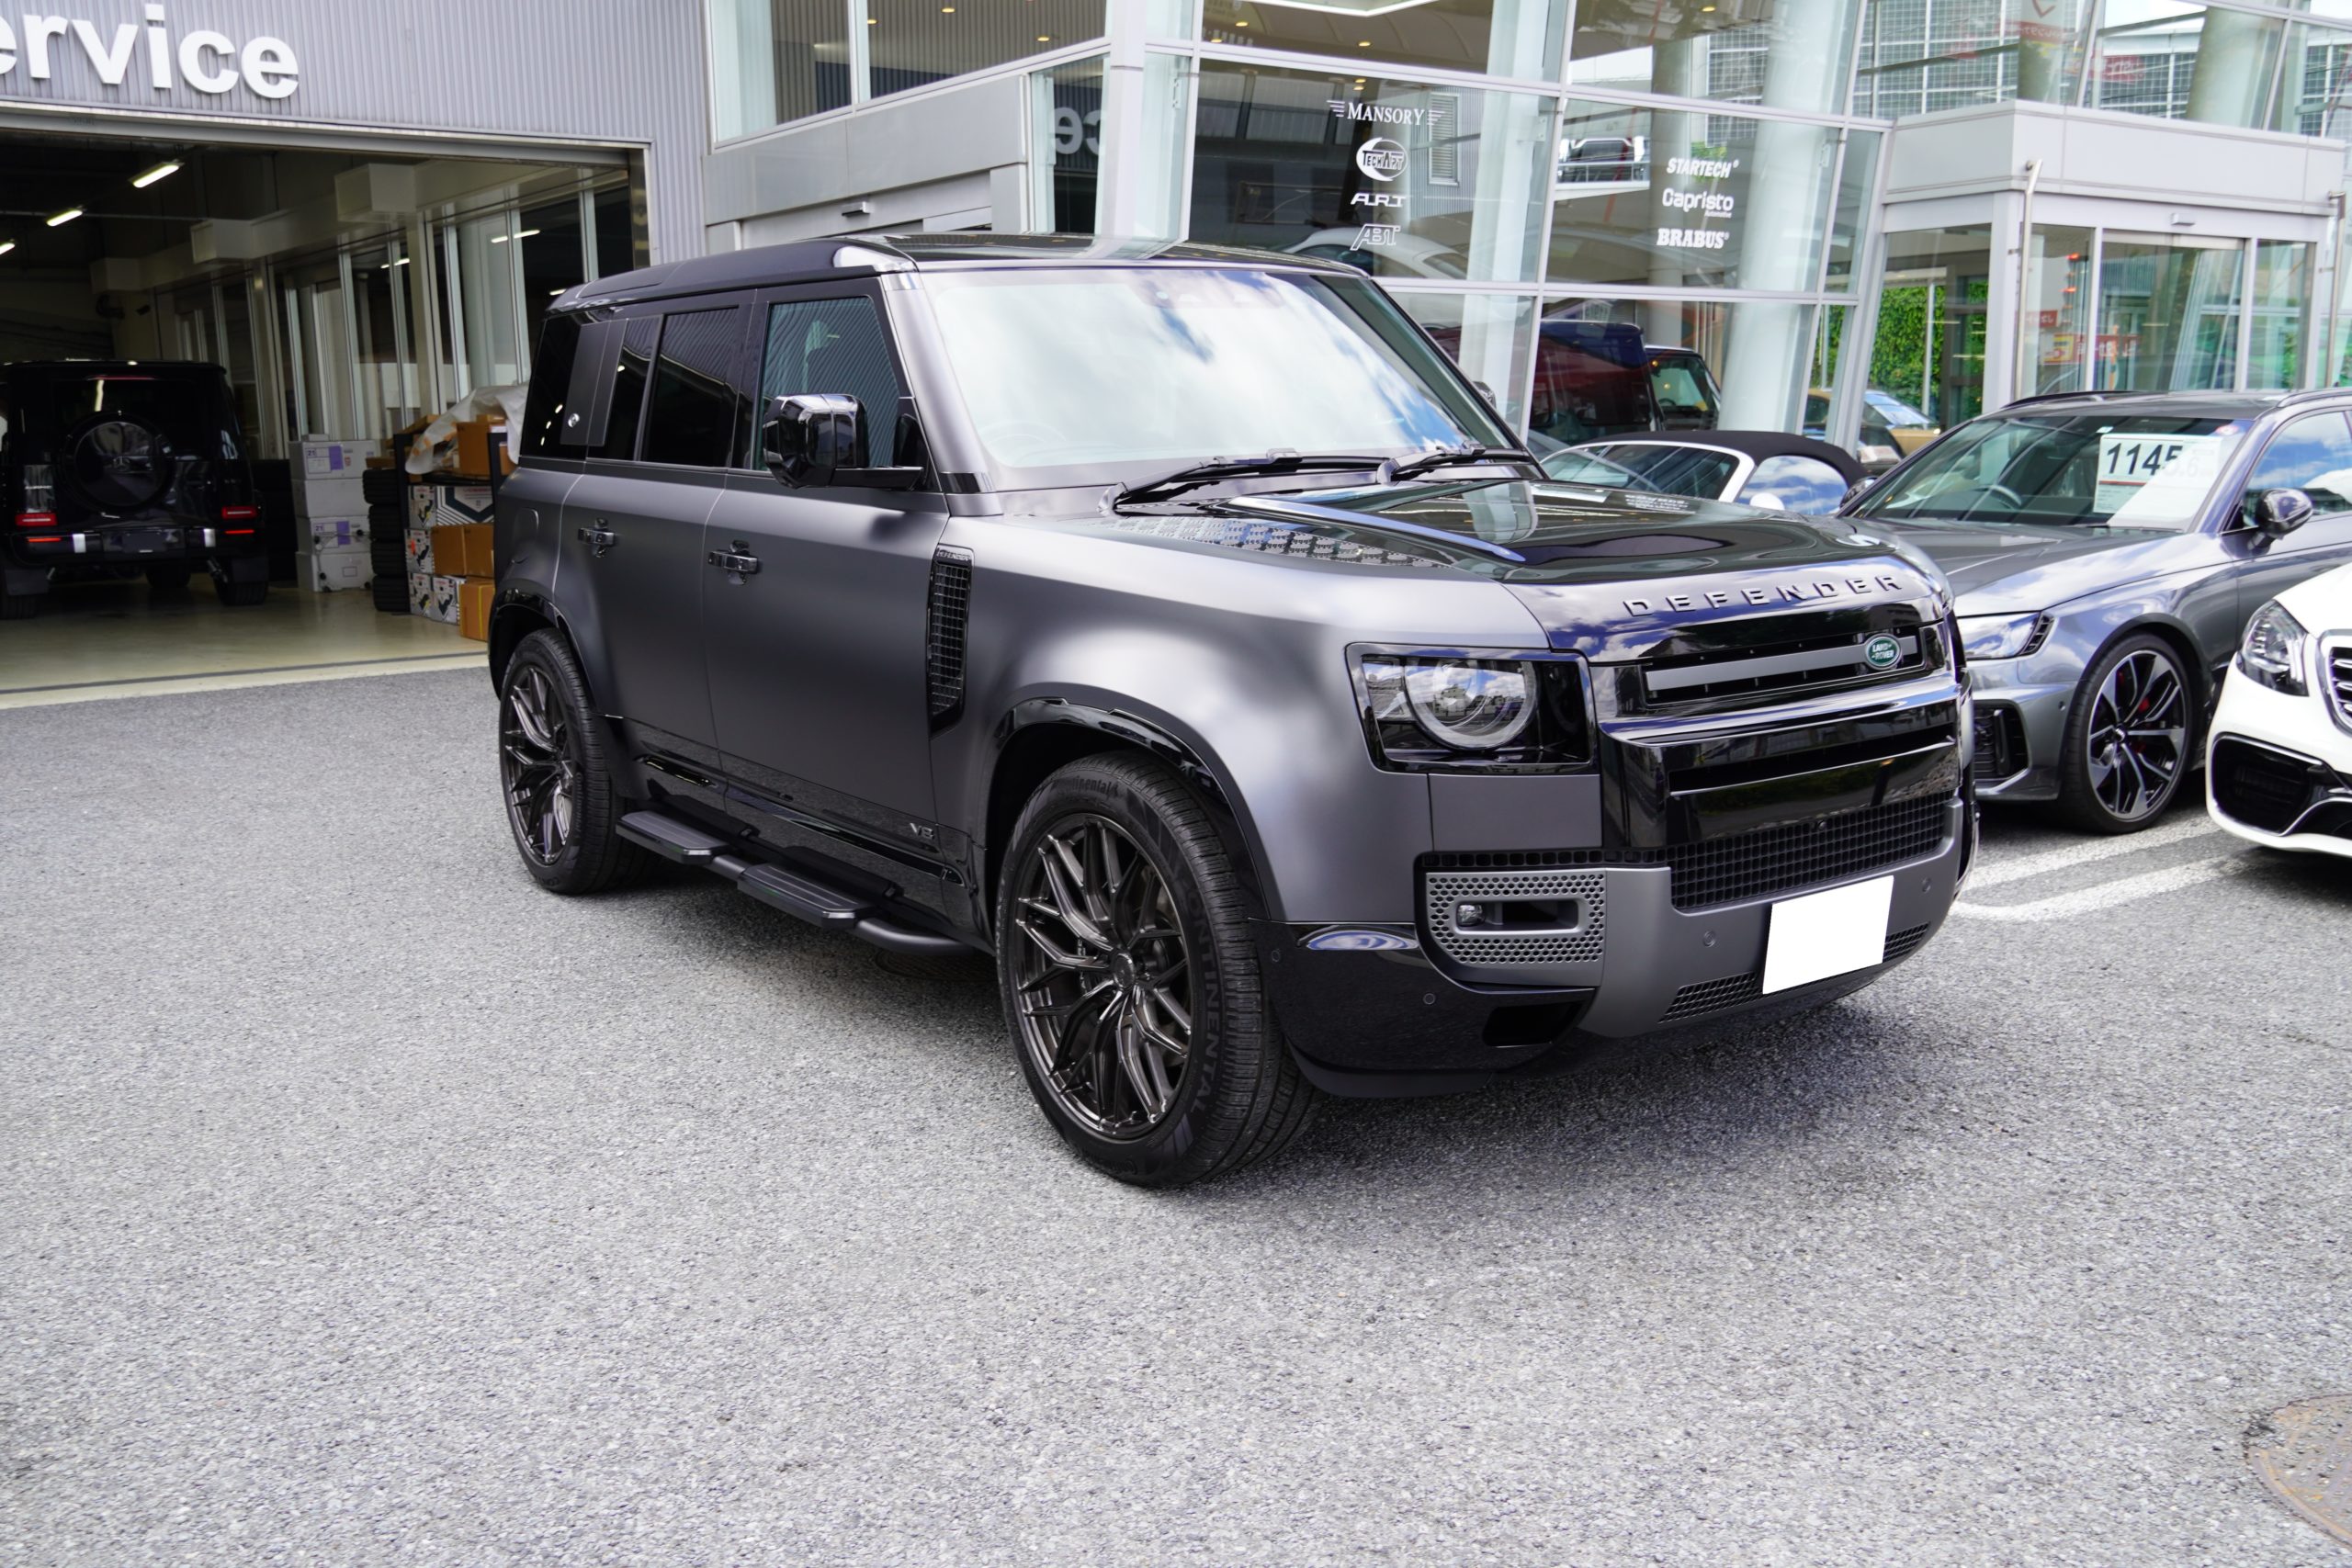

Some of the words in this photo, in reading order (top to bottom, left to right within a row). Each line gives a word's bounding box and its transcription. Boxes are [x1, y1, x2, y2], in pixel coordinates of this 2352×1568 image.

[1348, 102, 1425, 125] MANSORY
[1351, 192, 1406, 208] ART
[1662, 187, 1734, 212] Capristo
[1350, 223, 1401, 251] ABT
[1623, 574, 1903, 616] DEFENDER
[1871, 643, 1889, 653] LAND
[1875, 649, 1894, 660] ROVER
